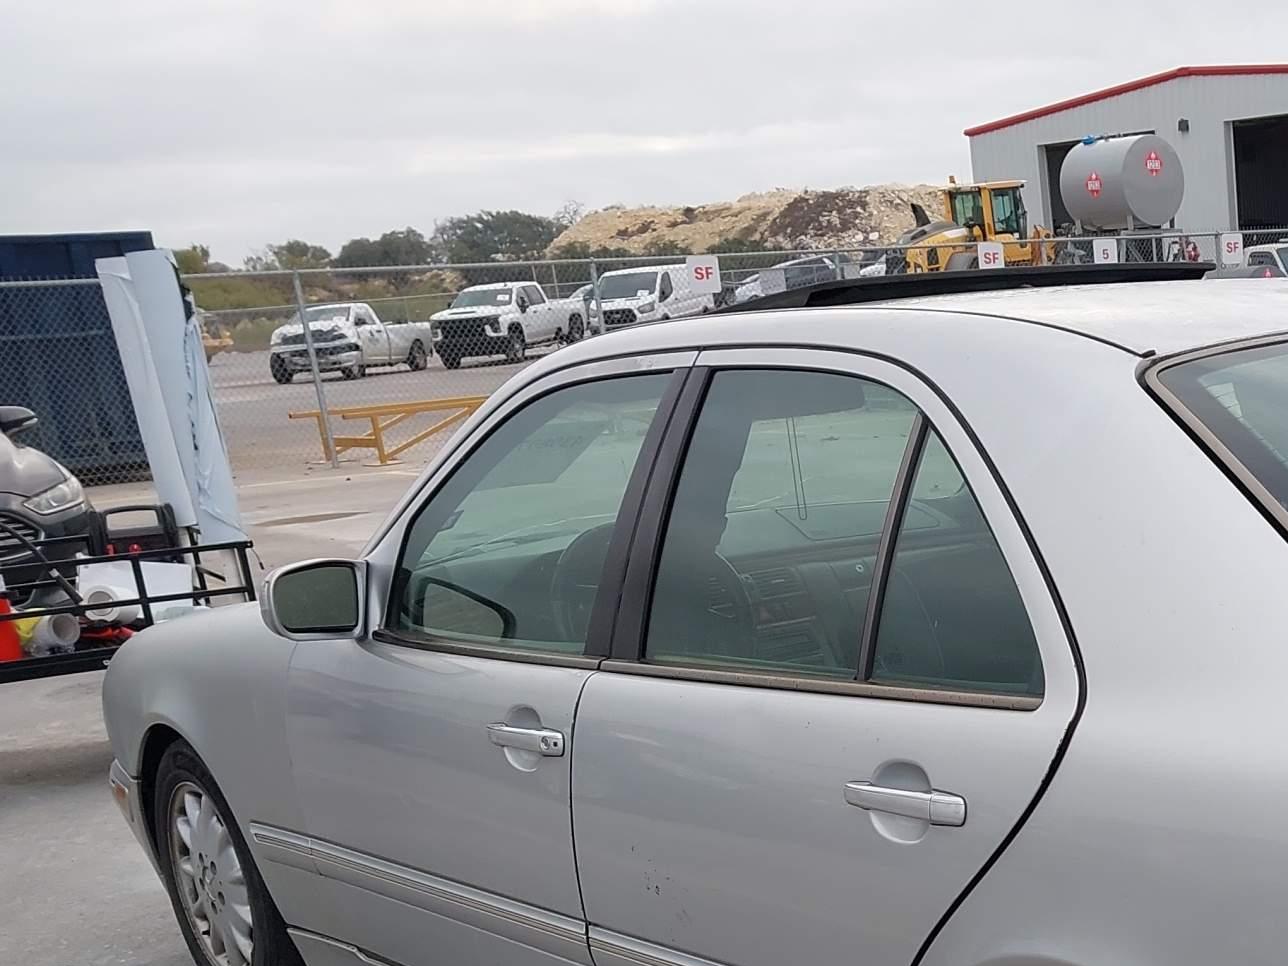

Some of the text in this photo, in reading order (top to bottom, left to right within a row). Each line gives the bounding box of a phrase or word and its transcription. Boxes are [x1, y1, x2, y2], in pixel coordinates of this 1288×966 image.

[1102, 248, 1110, 260] 5
[1226, 241, 1239, 254] SF
[983, 251, 999, 265] SF
[694, 266, 713, 281] SF
